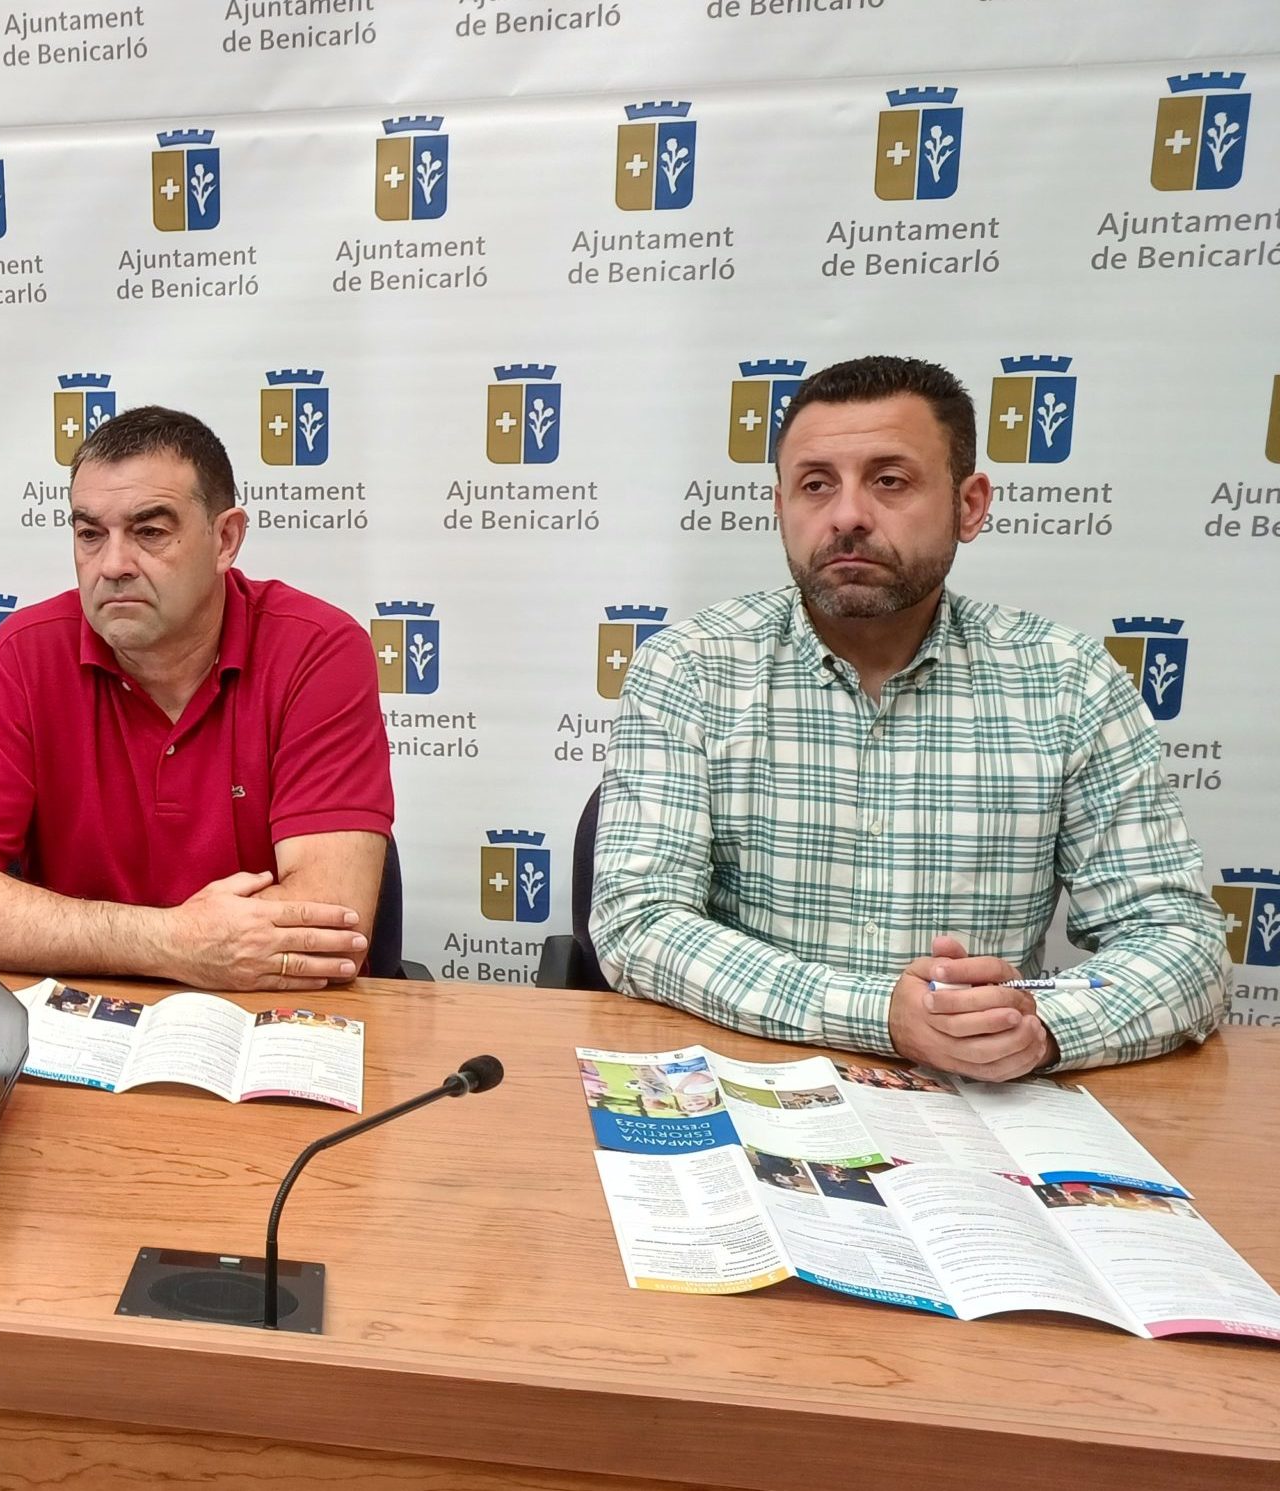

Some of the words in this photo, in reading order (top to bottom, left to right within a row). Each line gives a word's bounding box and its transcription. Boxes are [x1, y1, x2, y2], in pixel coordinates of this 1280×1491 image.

[224, 0, 375, 27] Ajuntament
[455, 13, 487, 37] de
[495, 3, 622, 35] Benicarló
[706, 0, 741, 18] de
[3, 5, 145, 41] Ajuntament
[222, 29, 252, 54] de
[260, 21, 377, 51] Benicarló
[2, 43, 31, 67] de
[37, 36, 148, 65] Benicarló
[571, 226, 735, 259] Ajuntament
[825, 217, 1000, 251] Ajuntament
[118, 245, 257, 276] Ajuntament
[335, 235, 487, 268] Ajuntament
[821, 252, 856, 277] de
[865, 248, 1000, 276] Benicarló
[1090, 245, 1128, 271] de
[332, 269, 362, 293] de
[370, 265, 488, 291] Benicarló
[567, 261, 600, 285] de
[608, 256, 735, 284] Benicarló
[116, 278, 144, 300] de
[151, 273, 259, 299] Benicarló
[445, 479, 598, 507] Ajuntament
[683, 479, 773, 507] Ajunta
[991, 482, 1113, 504] ntament
[20, 507, 47, 528] de
[258, 508, 369, 530] Benicarló
[443, 508, 473, 530] de
[481, 508, 600, 531] Benicarló
[680, 509, 712, 531] de
[1204, 513, 1241, 538] de
[389, 736, 479, 758] enicarló
[554, 740, 584, 762] de
[443, 932, 544, 958] Ajuntam
[441, 959, 470, 980] de
[477, 962, 540, 985] Benic
[615, 1118, 658, 1130] 2023
[618, 1126, 713, 1140] ESPORTIVA
[661, 1122, 711, 1131] D'ESTIU
[620, 1134, 716, 1147] CAMPANYA
